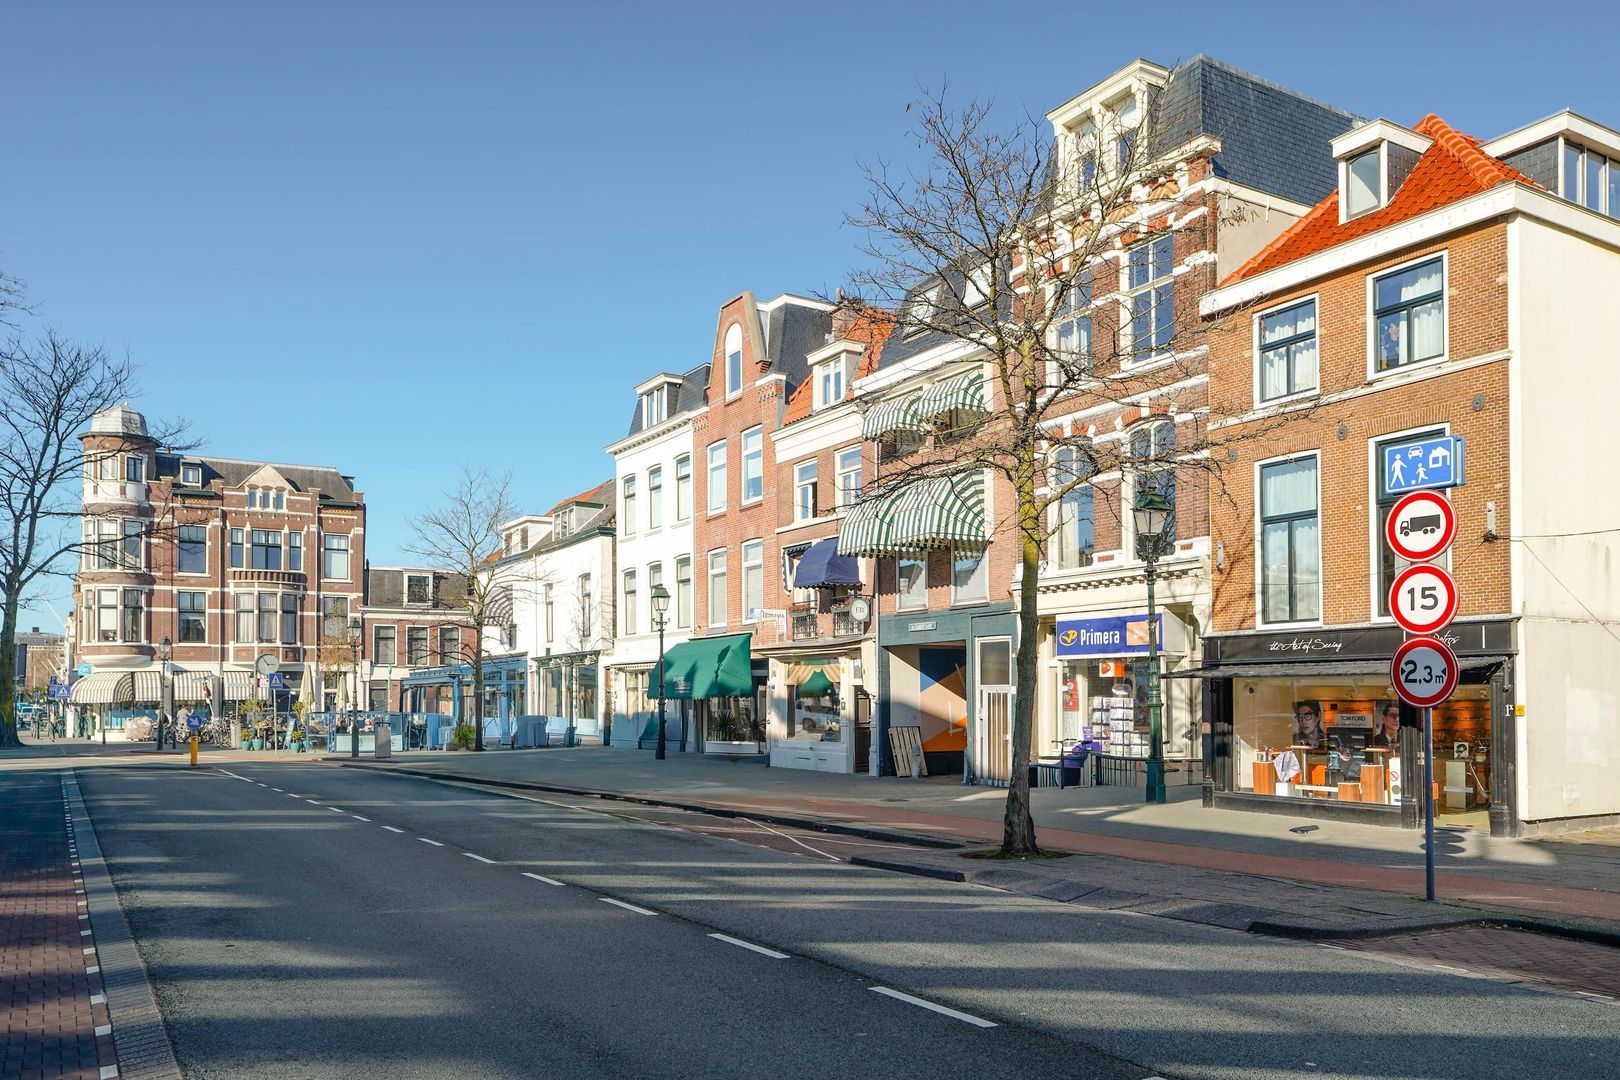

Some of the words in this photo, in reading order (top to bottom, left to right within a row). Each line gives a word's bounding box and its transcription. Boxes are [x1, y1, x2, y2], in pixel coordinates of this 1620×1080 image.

[1407, 586, 1439, 611] 15
[1080, 628, 1120, 646] Primera
[1312, 638, 1343, 653] Seeing
